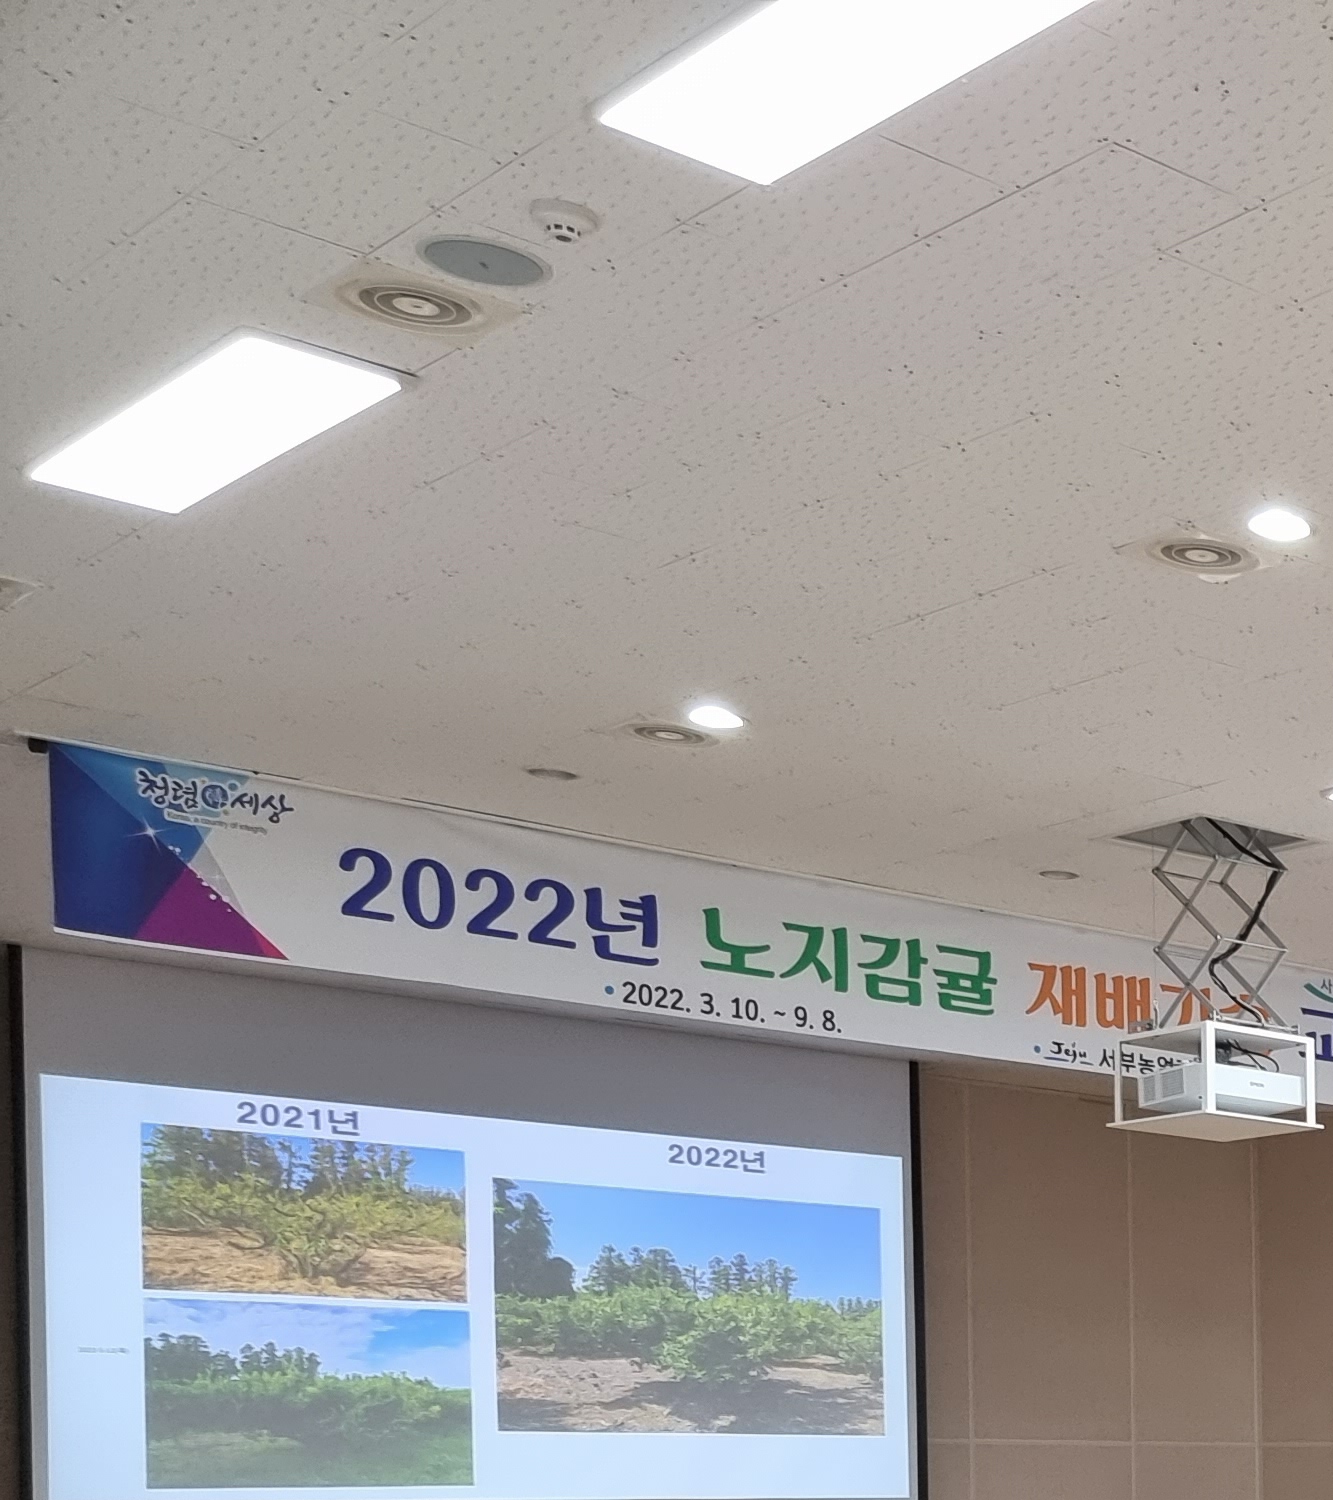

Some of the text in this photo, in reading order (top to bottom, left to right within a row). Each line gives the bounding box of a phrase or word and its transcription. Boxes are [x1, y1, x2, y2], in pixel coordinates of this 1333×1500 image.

[136, 770, 295, 824] 청렴 세상
[339, 847, 660, 967] 2022년
[699, 907, 998, 1016] 노지감귤
[621, 980, 692, 1013] 2022.
[699, 992, 721, 1018] 3.
[730, 996, 766, 1024] 10.
[794, 1005, 815, 1030] 9.
[822, 1009, 843, 1034] 8.
[1049, 1040, 1088, 1063] Jeju
[236, 1100, 361, 1137] 2021년
[667, 1143, 767, 1174] 2022년
